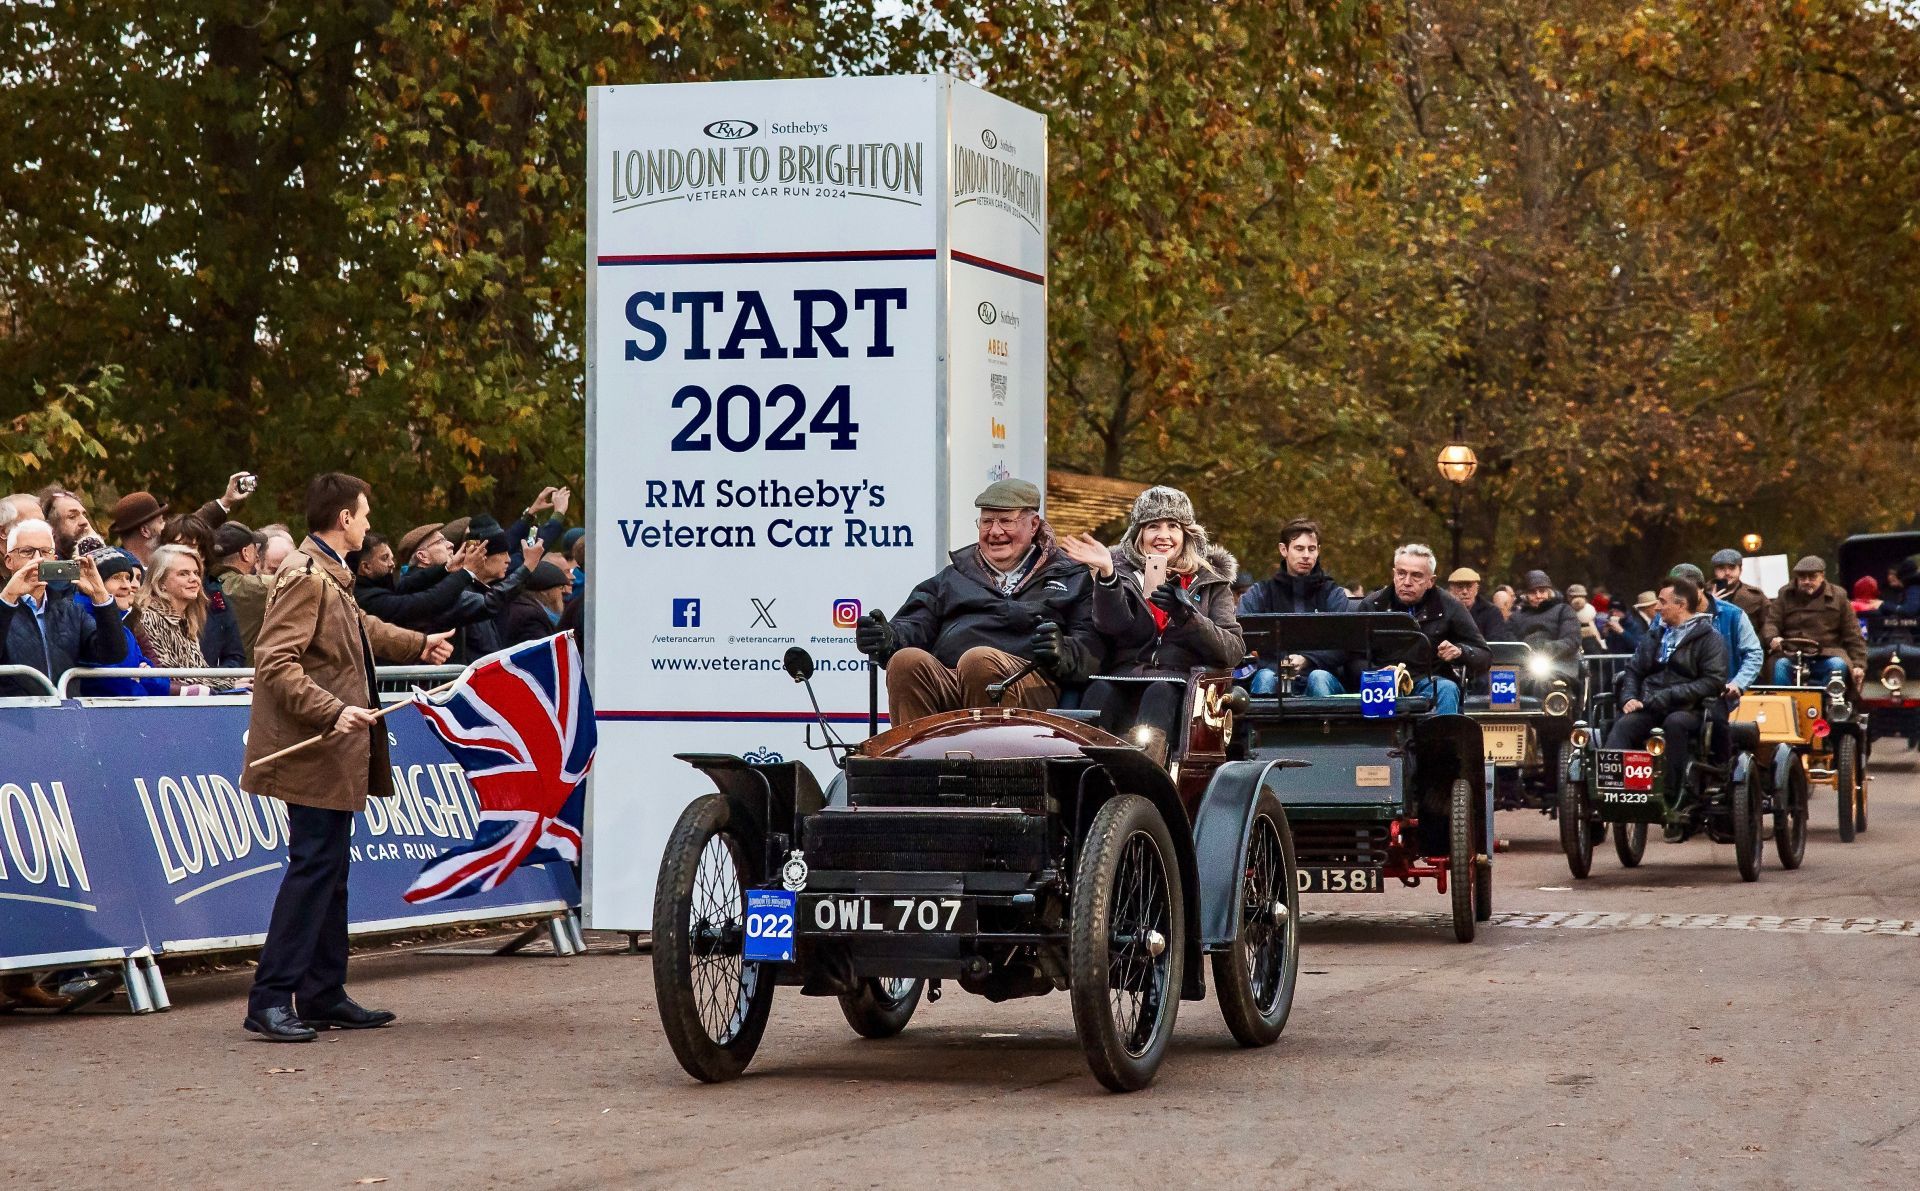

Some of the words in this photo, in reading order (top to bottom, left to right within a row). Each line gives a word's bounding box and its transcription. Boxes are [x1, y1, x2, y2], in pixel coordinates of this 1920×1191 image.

[713, 121, 747, 139] RM
[771, 122, 828, 136] Sotheby's
[612, 147, 726, 203] LONDON
[733, 145, 770, 184] TO
[778, 142, 923, 196] BRIGHTON
[954, 144, 988, 198] LONDON
[990, 157, 1000, 196] TO
[1002, 162, 1040, 226] BRIGHTON
[686, 188, 746, 202] VETERAN
[752, 187, 778, 196] CAR
[784, 187, 810, 196] RUN
[815, 188, 846, 199] 2024
[624, 287, 908, 362] START
[988, 338, 1008, 357] ABELS
[671, 384, 860, 452] 2024
[645, 480, 705, 508] RM
[716, 479, 886, 514] Sotheby's
[618, 519, 756, 548] Veteran
[767, 518, 833, 548] Car
[844, 518, 914, 548] Run
[652, 634, 715, 644] /veterancarrun
[728, 635, 796, 644] @veterancarrun
[810, 636, 858, 644] #veteranca
[651, 656, 870, 672] www.veterancun.com
[1362, 688, 1396, 704] 034
[1492, 682, 1516, 694] 054
[1600, 763, 1622, 773] 1901
[1625, 765, 1652, 778] 049
[1604, 793, 1618, 803] JM
[1619, 793, 1648, 803] 3239
[366, 843, 401, 861] CAR
[402, 842, 438, 860] RUN
[1322, 870, 1377, 891] 1381
[814, 900, 884, 930] OWL
[894, 900, 962, 931] 707
[746, 914, 793, 938] 022
